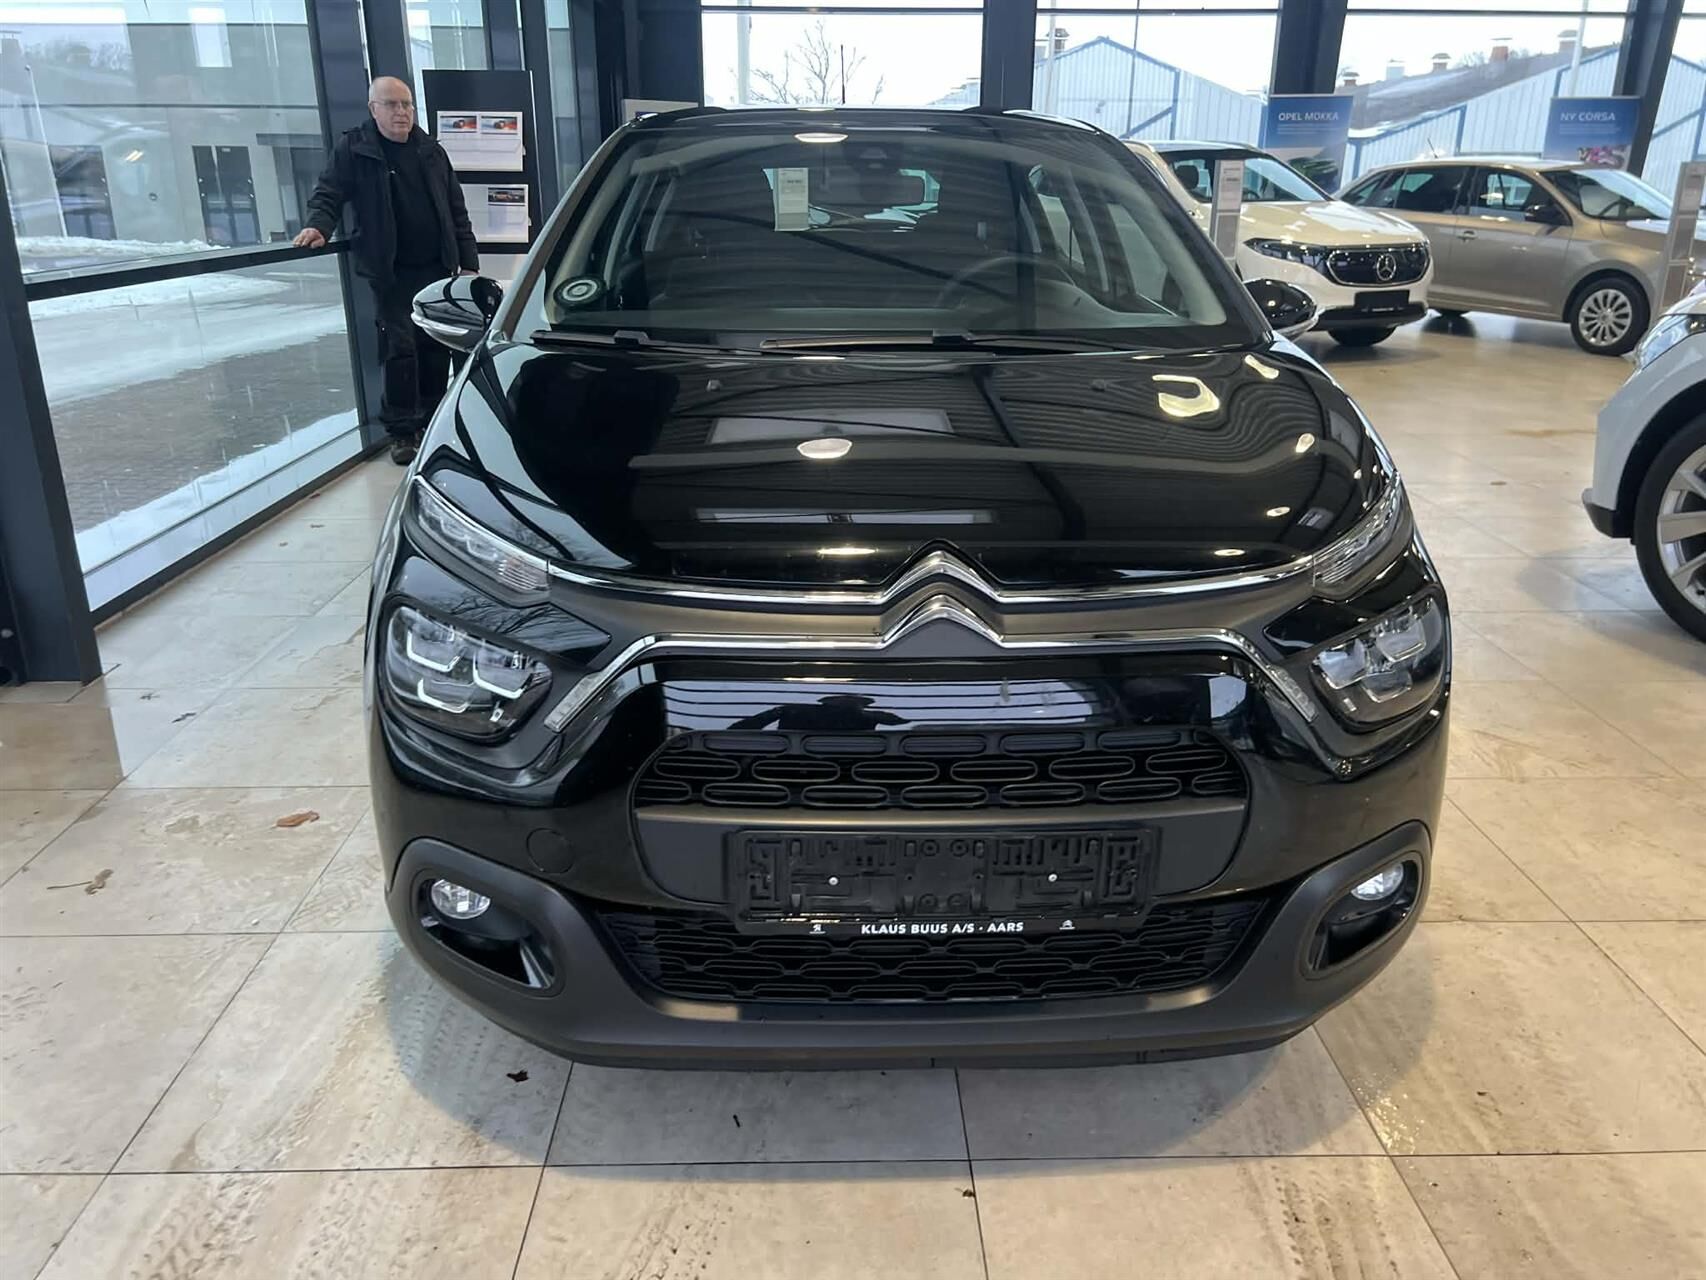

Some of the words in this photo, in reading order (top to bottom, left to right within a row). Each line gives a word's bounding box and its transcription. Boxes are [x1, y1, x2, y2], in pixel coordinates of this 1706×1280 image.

[1278, 111, 1302, 121] OPEL
[1304, 111, 1339, 121] MOKKA
[1560, 111, 1577, 121] NY
[1578, 111, 1616, 121] CORSA
[861, 924, 906, 934] KLAUS
[910, 923, 948, 934] BUUS
[951, 922, 975, 934] A/S
[986, 921, 1024, 933] AARS
